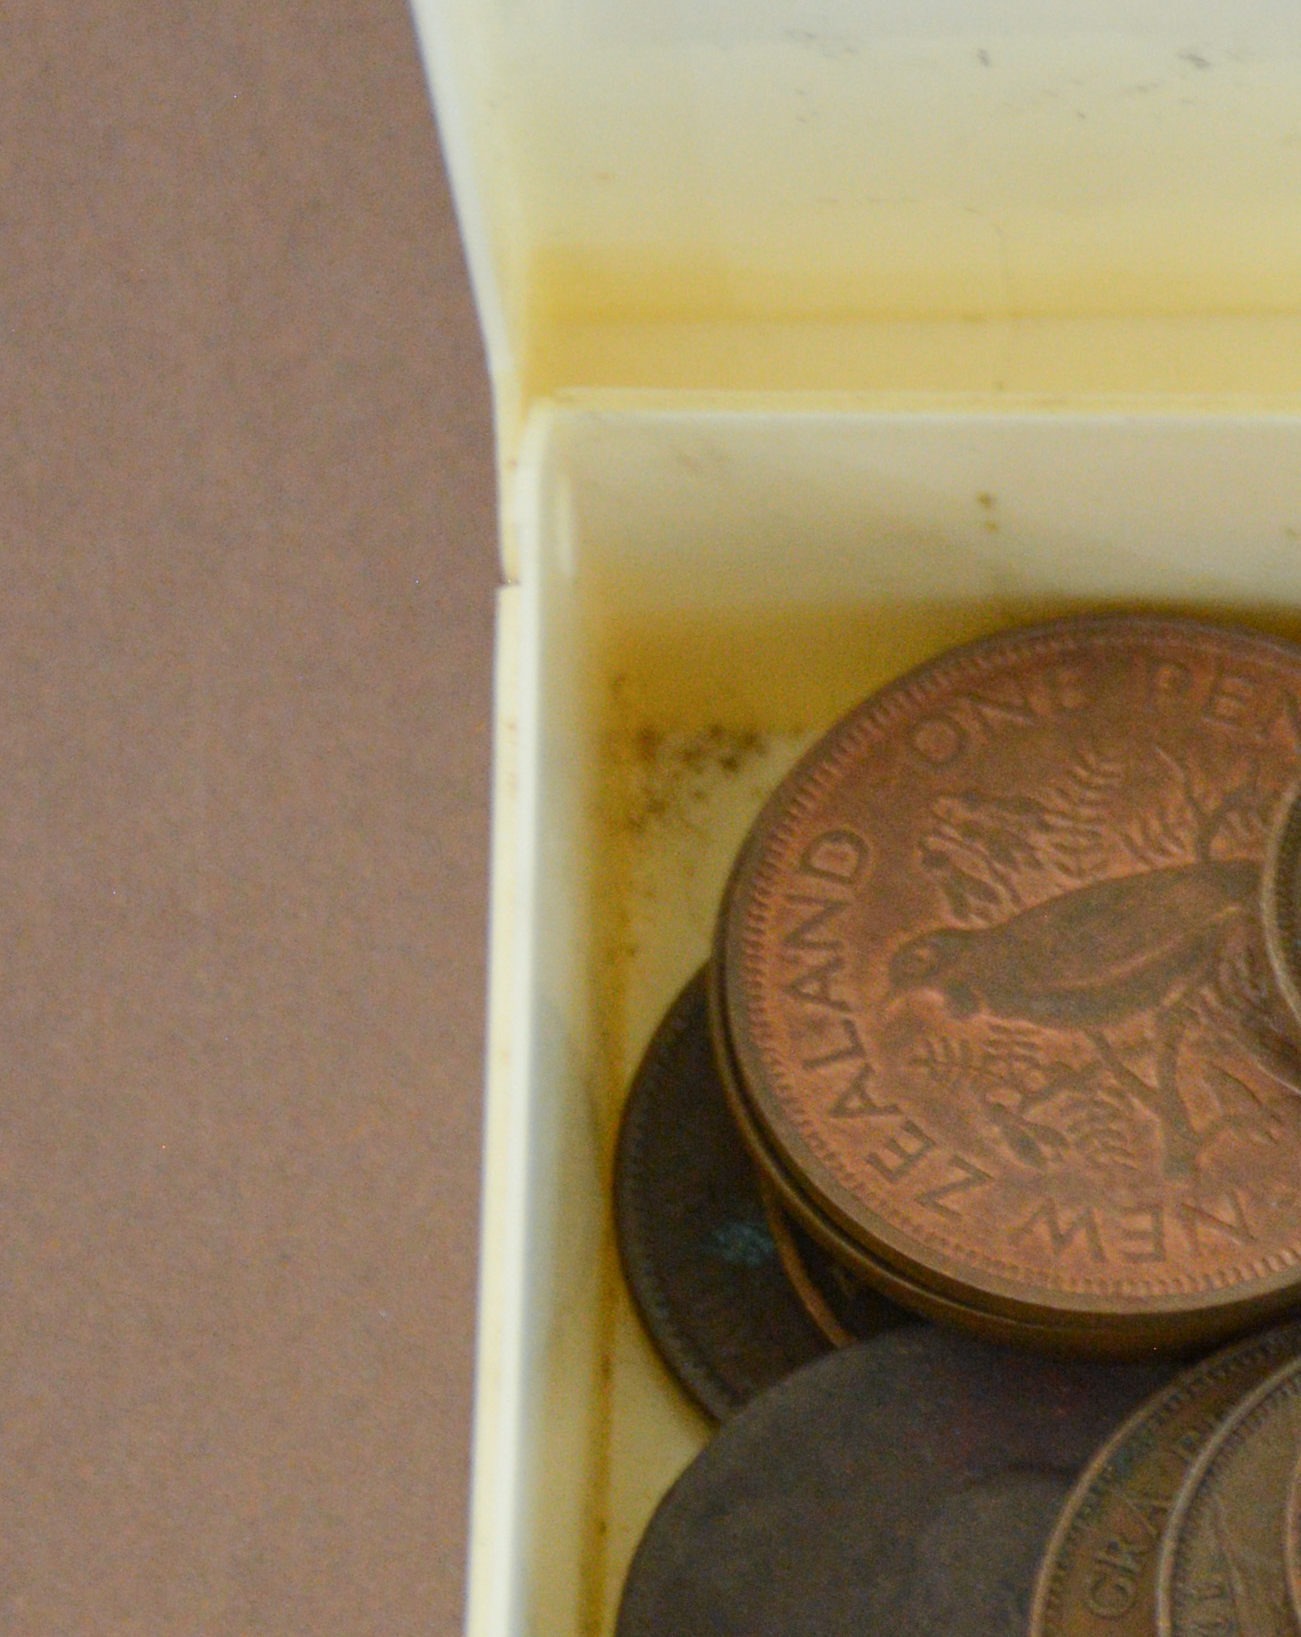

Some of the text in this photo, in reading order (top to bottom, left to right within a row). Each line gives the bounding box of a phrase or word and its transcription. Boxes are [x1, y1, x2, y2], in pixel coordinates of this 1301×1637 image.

[906, 666, 1100, 766] ONE
[780, 824, 1258, 1264] NEW ZEALAND
